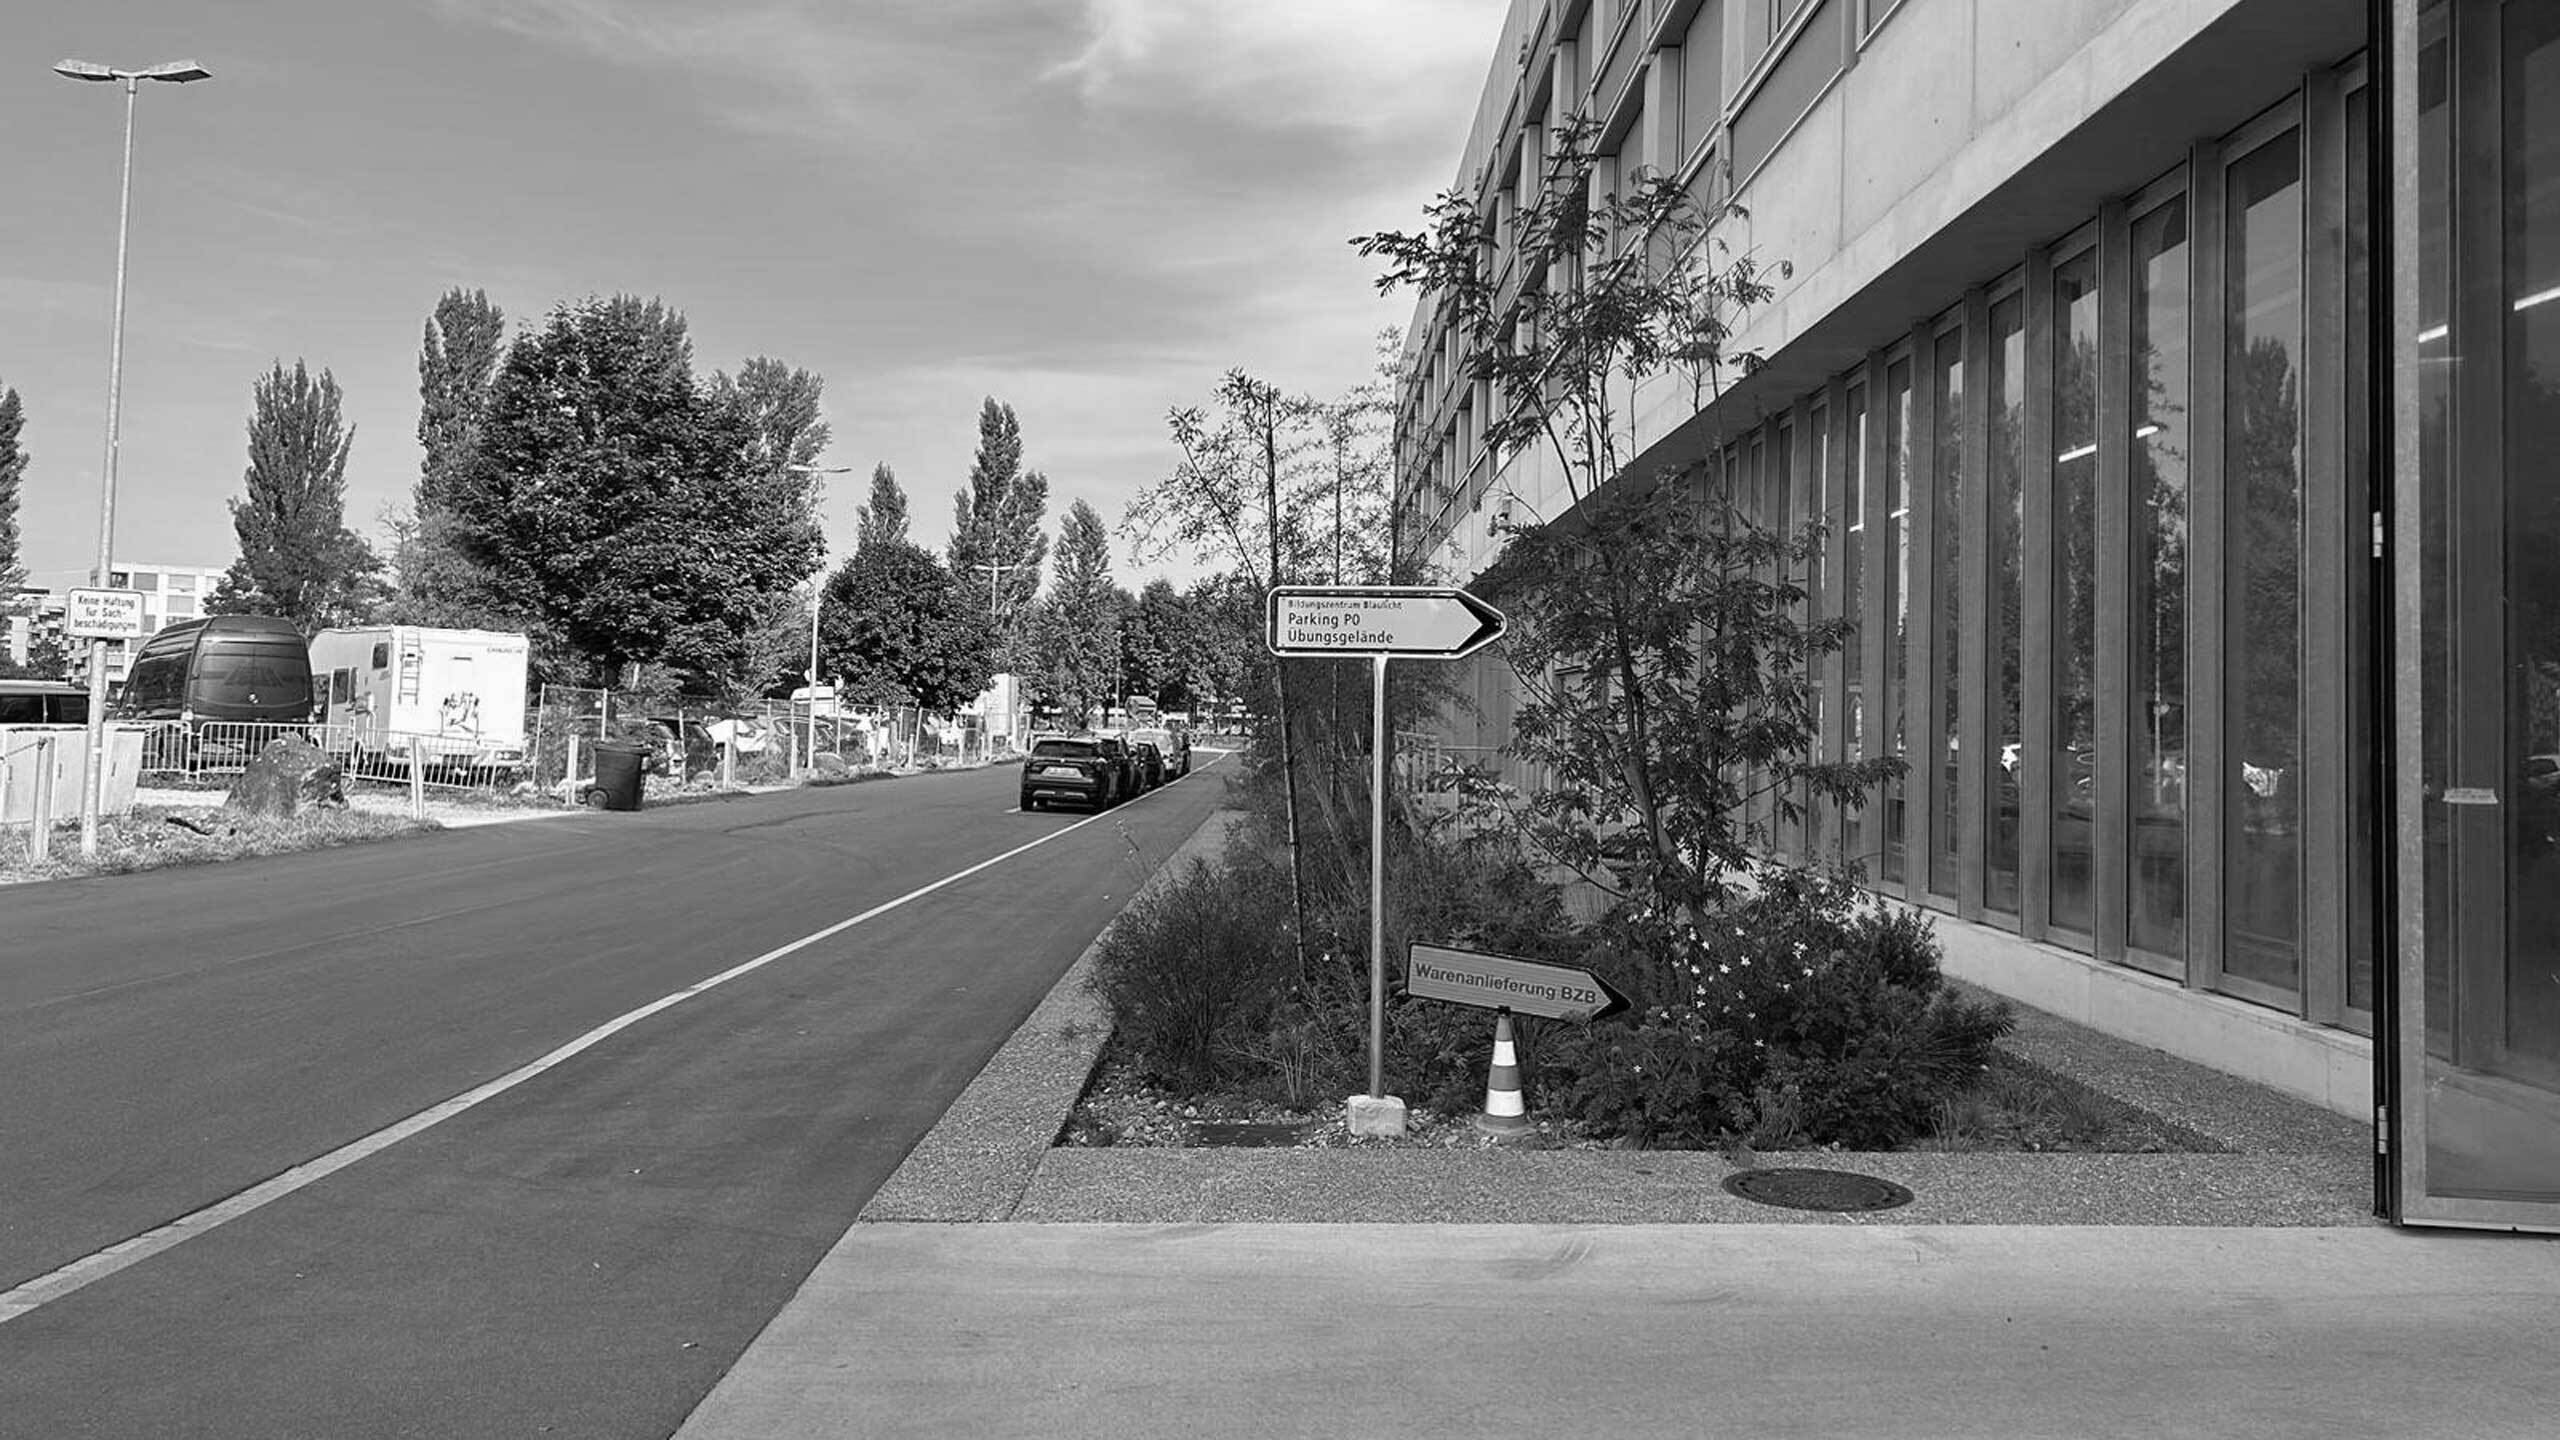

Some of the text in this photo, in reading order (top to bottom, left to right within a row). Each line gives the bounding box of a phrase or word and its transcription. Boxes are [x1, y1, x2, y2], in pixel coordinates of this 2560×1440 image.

[1287, 612, 1339, 630] Parking
[1287, 627, 1394, 646] Übungsgelände
[1415, 963, 1597, 1005] Warenanlieferung BZB
